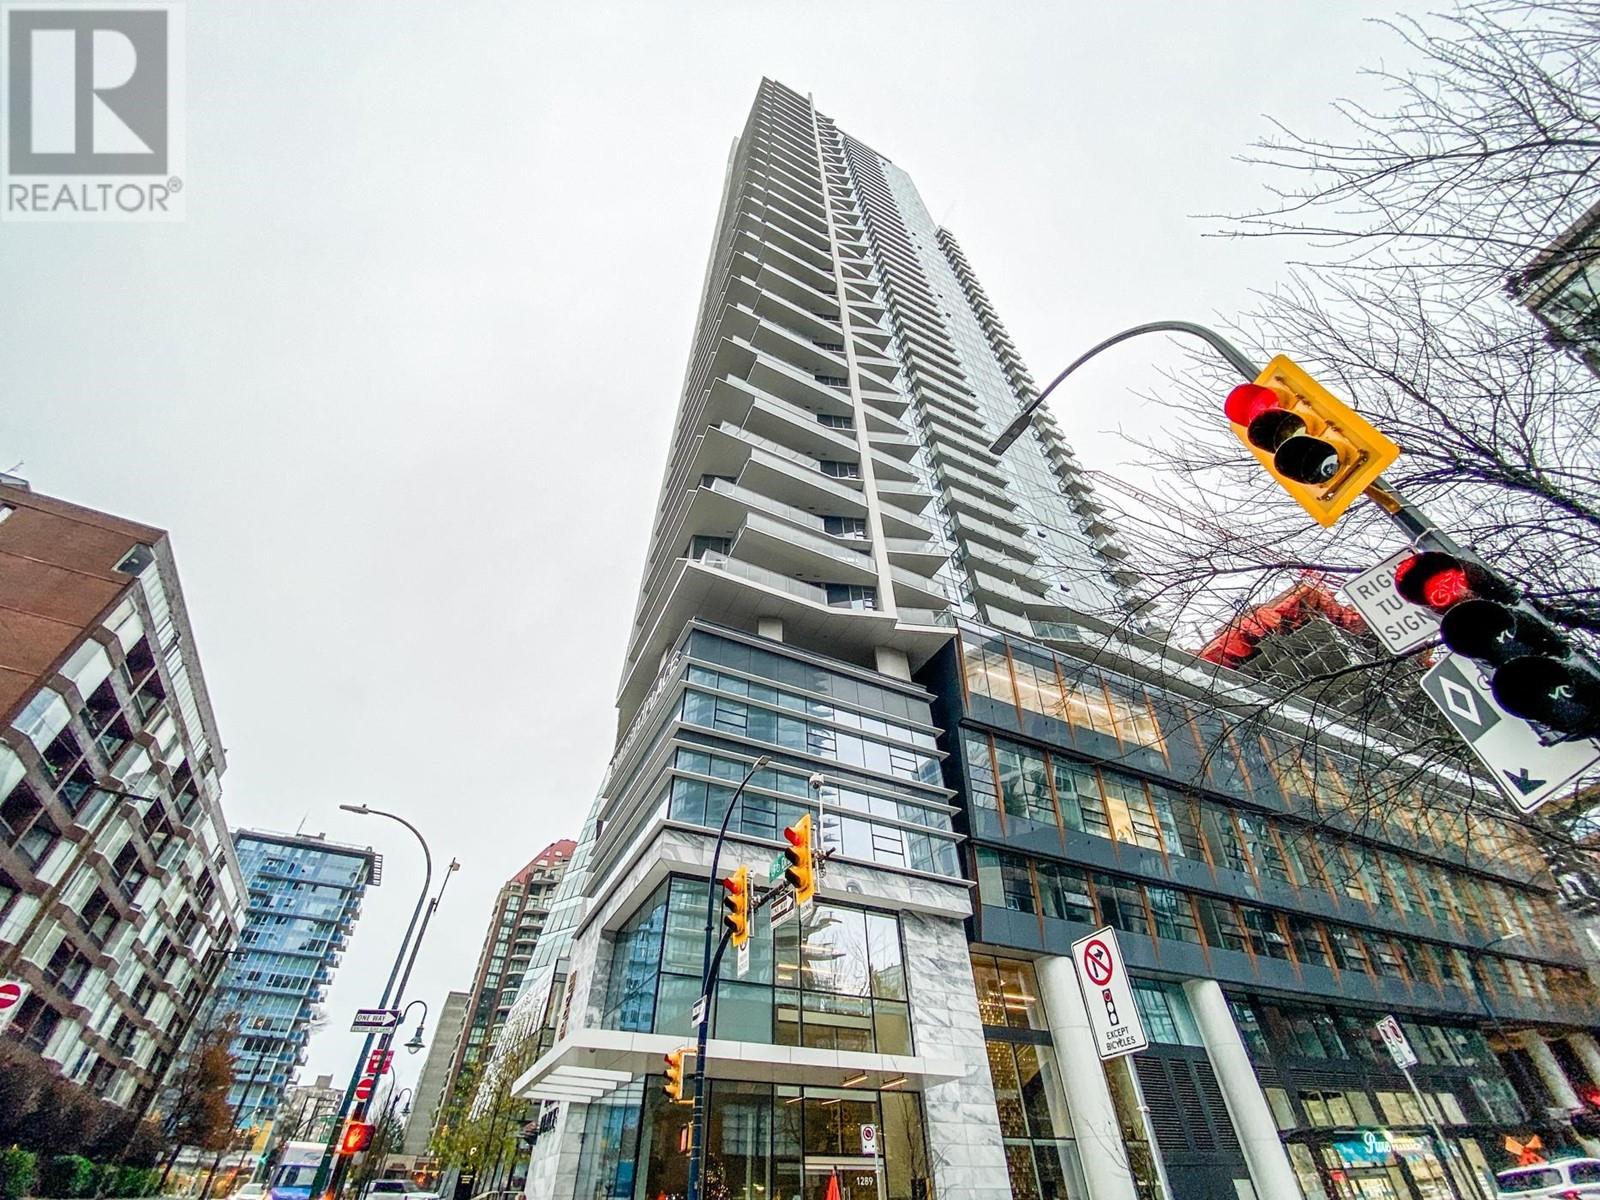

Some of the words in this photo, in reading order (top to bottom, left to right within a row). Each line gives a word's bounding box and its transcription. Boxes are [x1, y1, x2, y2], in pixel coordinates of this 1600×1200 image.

[1375, 594, 1404, 615] TU
[1384, 610, 1428, 641] SIGN
[1106, 1026, 1129, 1039] EXCEPT
[1106, 1035, 1136, 1051] BICYCLES
[856, 1176, 874, 1187] 1289
